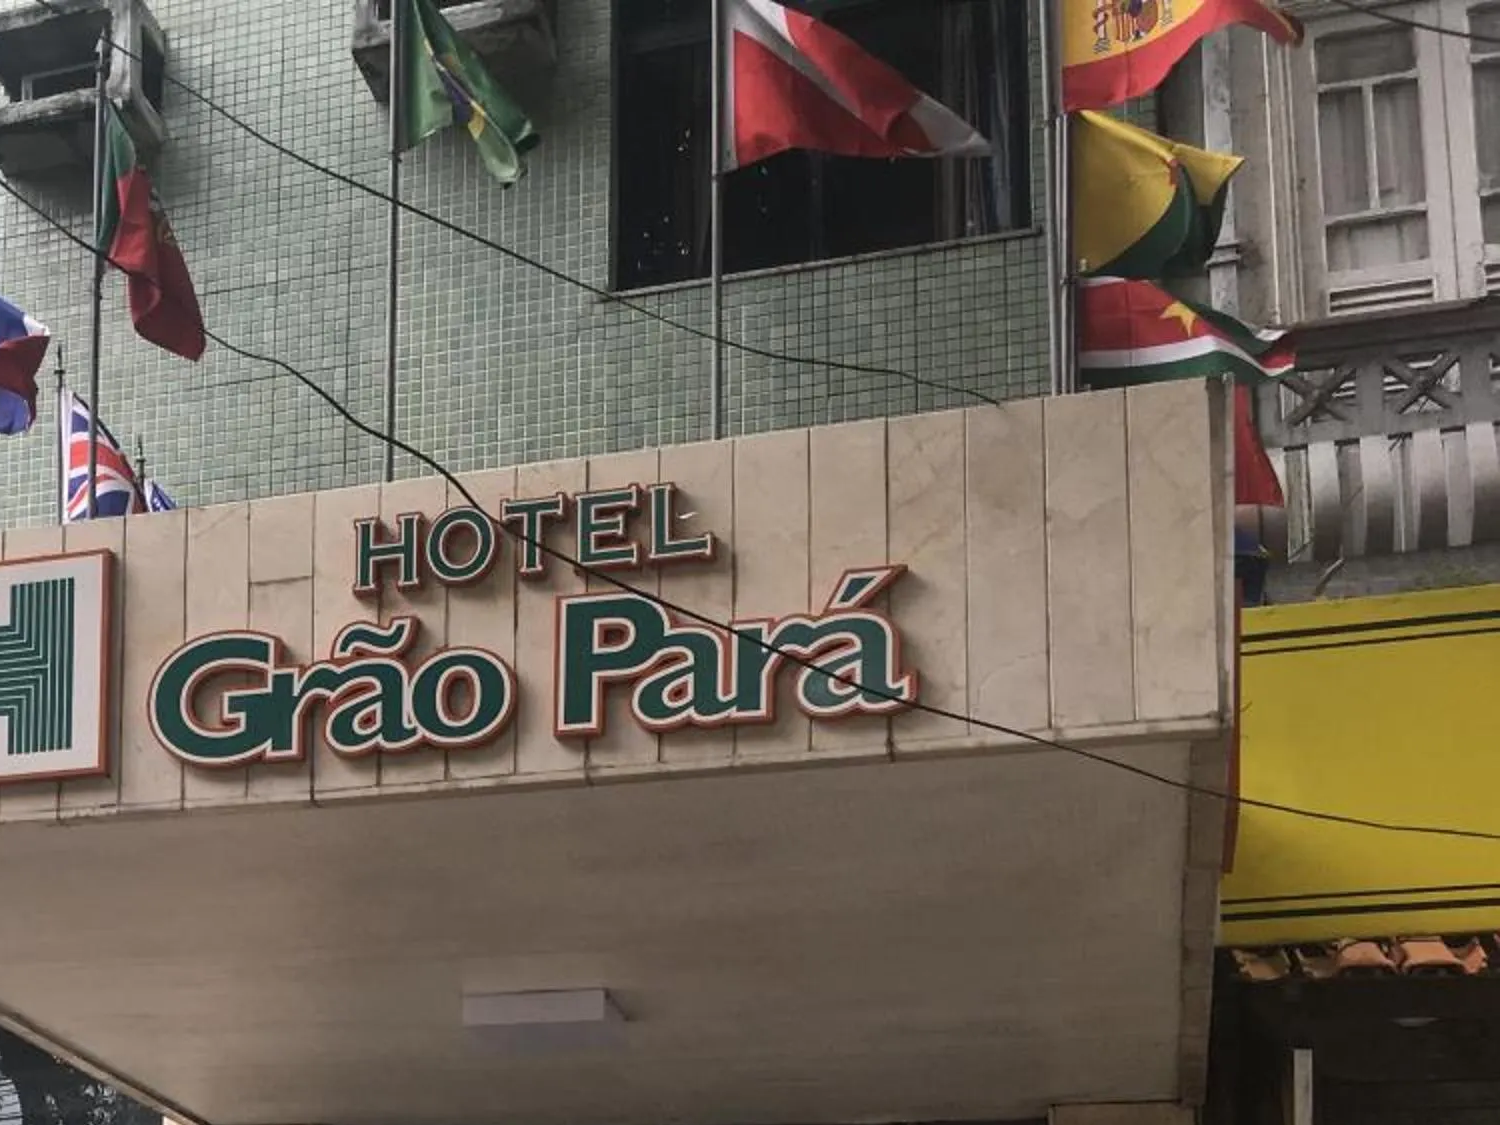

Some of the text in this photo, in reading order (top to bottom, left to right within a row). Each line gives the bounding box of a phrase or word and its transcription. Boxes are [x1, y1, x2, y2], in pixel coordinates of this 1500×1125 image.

[353, 483, 716, 597] HOTEL
[150, 564, 918, 766] Grão Pará
